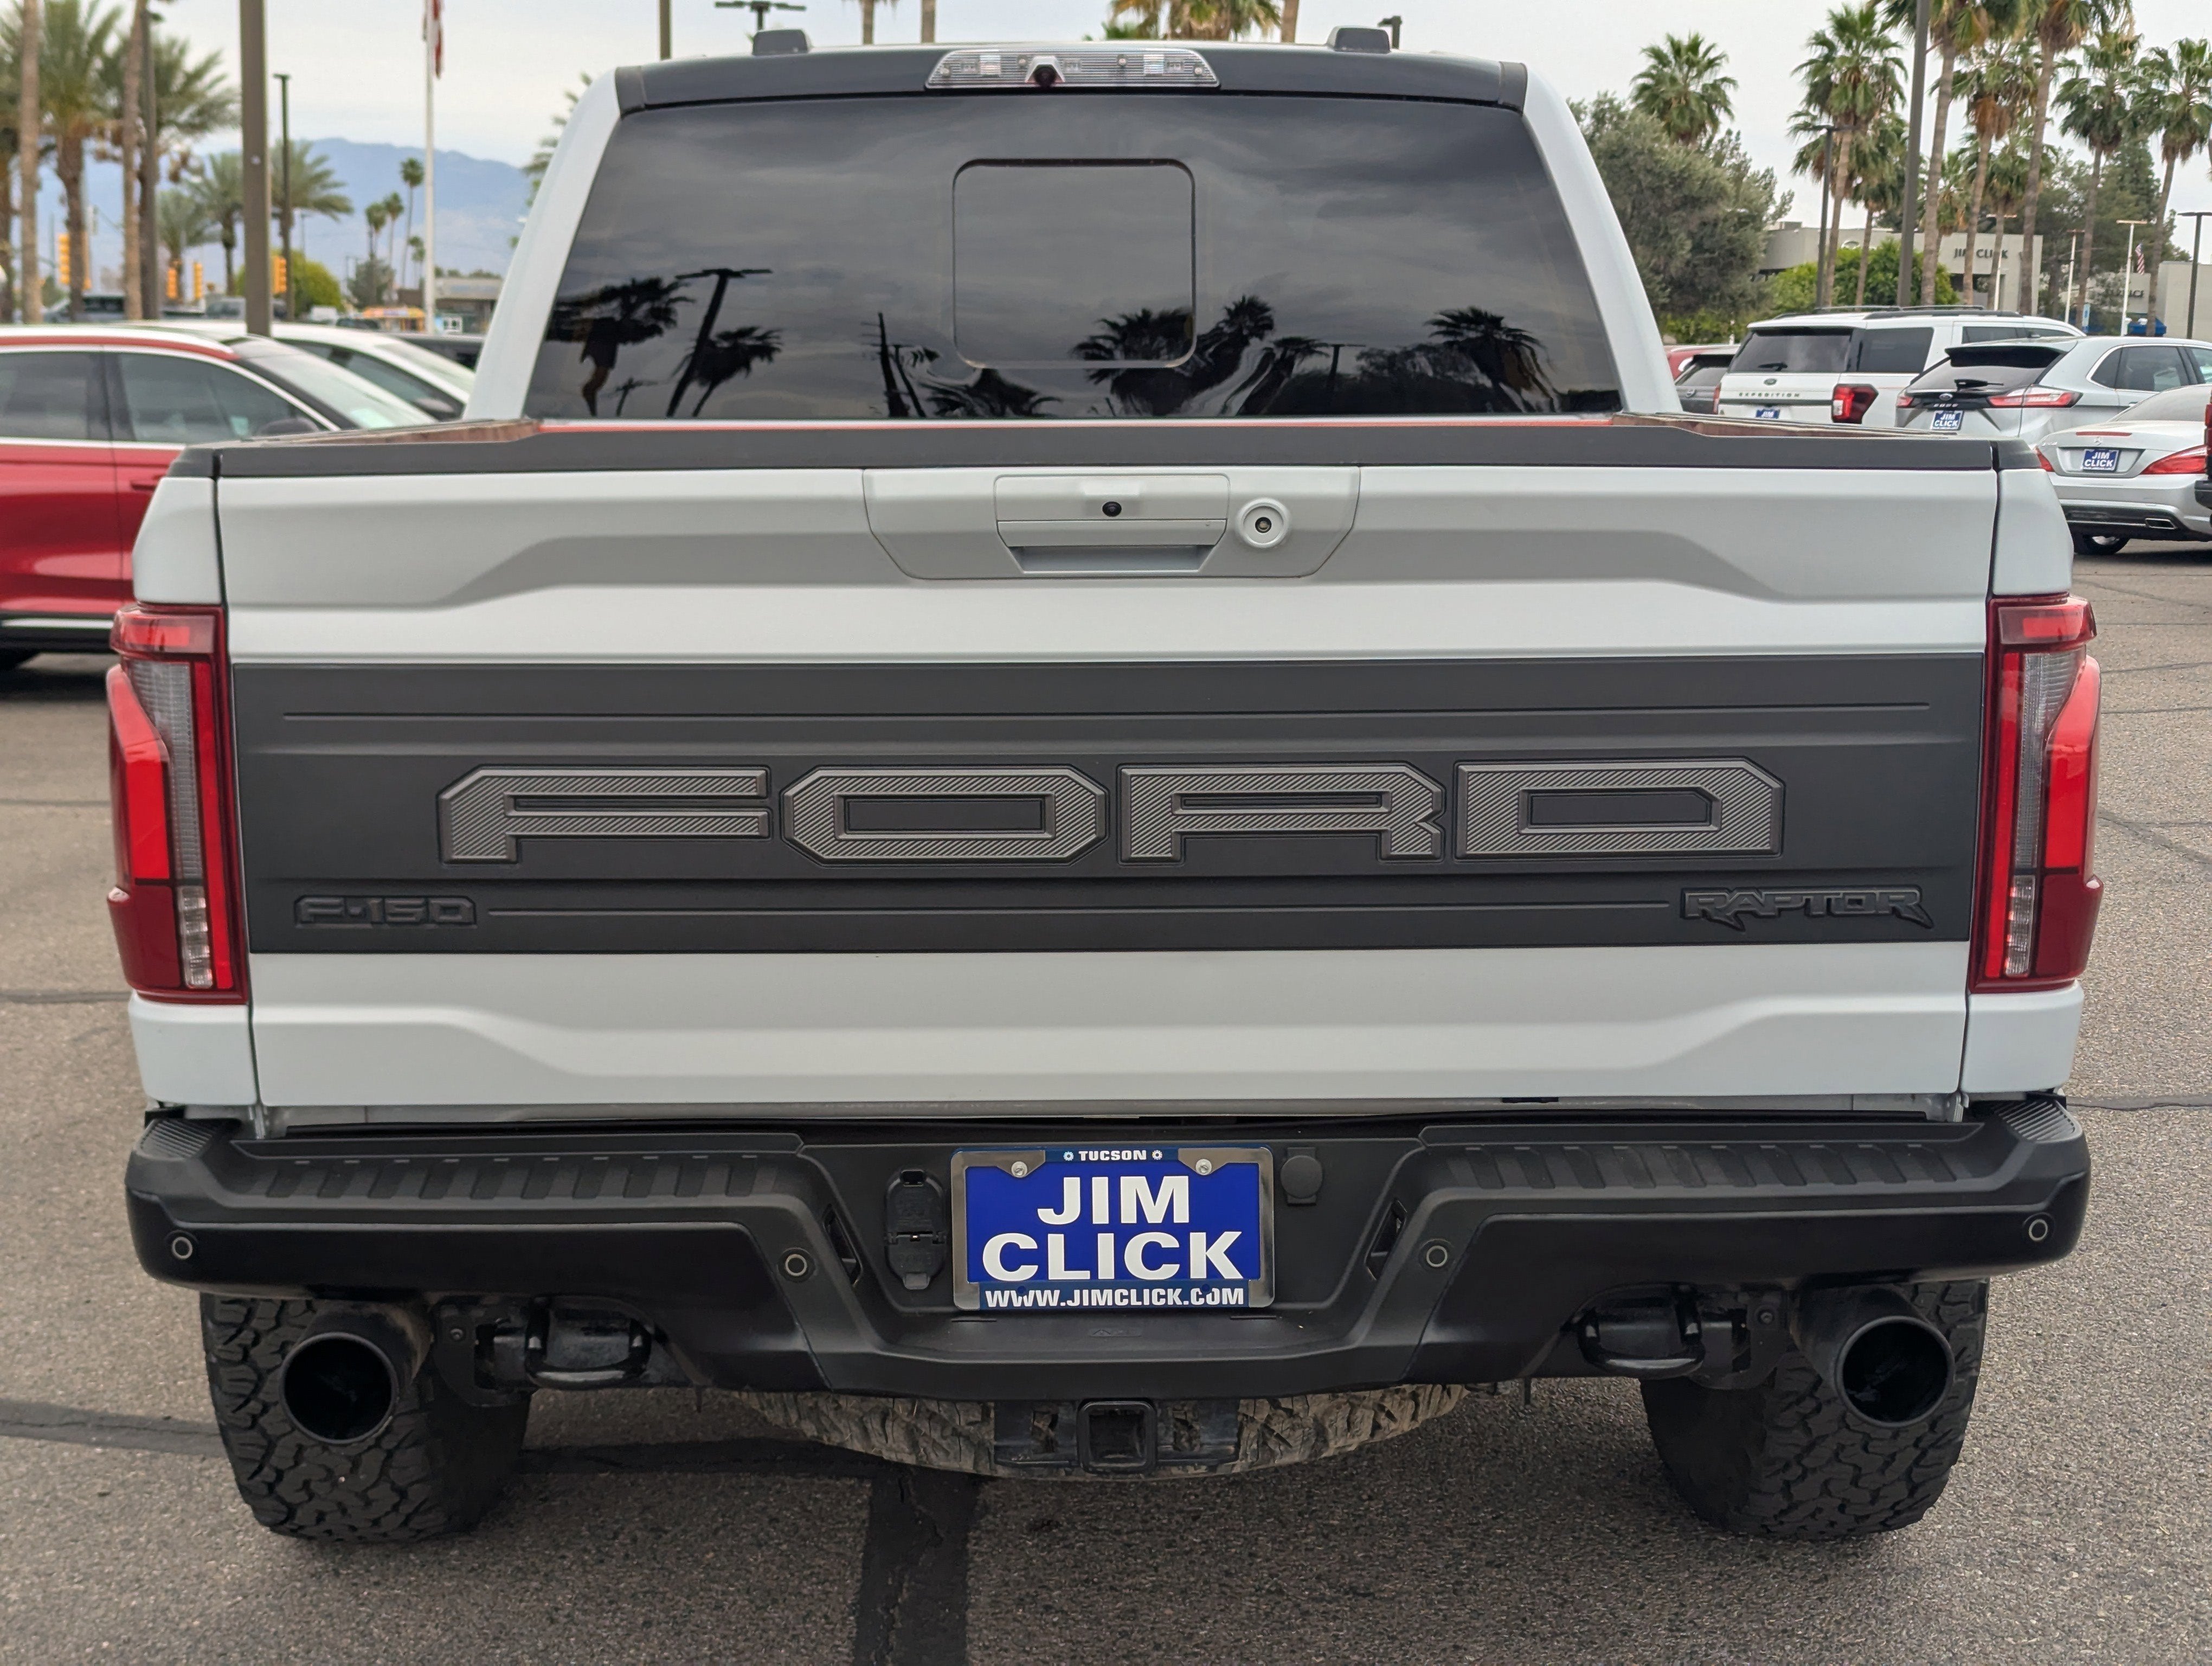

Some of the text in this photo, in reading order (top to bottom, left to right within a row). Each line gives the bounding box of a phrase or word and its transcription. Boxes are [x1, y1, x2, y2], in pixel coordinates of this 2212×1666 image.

[1976, 248, 2008, 259] CLIK
[2084, 459, 2113, 467] CLICK
[2092, 451, 2110, 459] JIM
[440, 758, 1784, 863] FORD
[295, 895, 477, 924] F-150
[1681, 887, 1934, 931] RAPTOR
[1079, 1150, 1147, 1161] TUCSON
[1037, 1176, 1189, 1225] JIM
[982, 1231, 1244, 1281] CLICK
[985, 1288, 1244, 1308] WWW.JIMCLICK.COM
